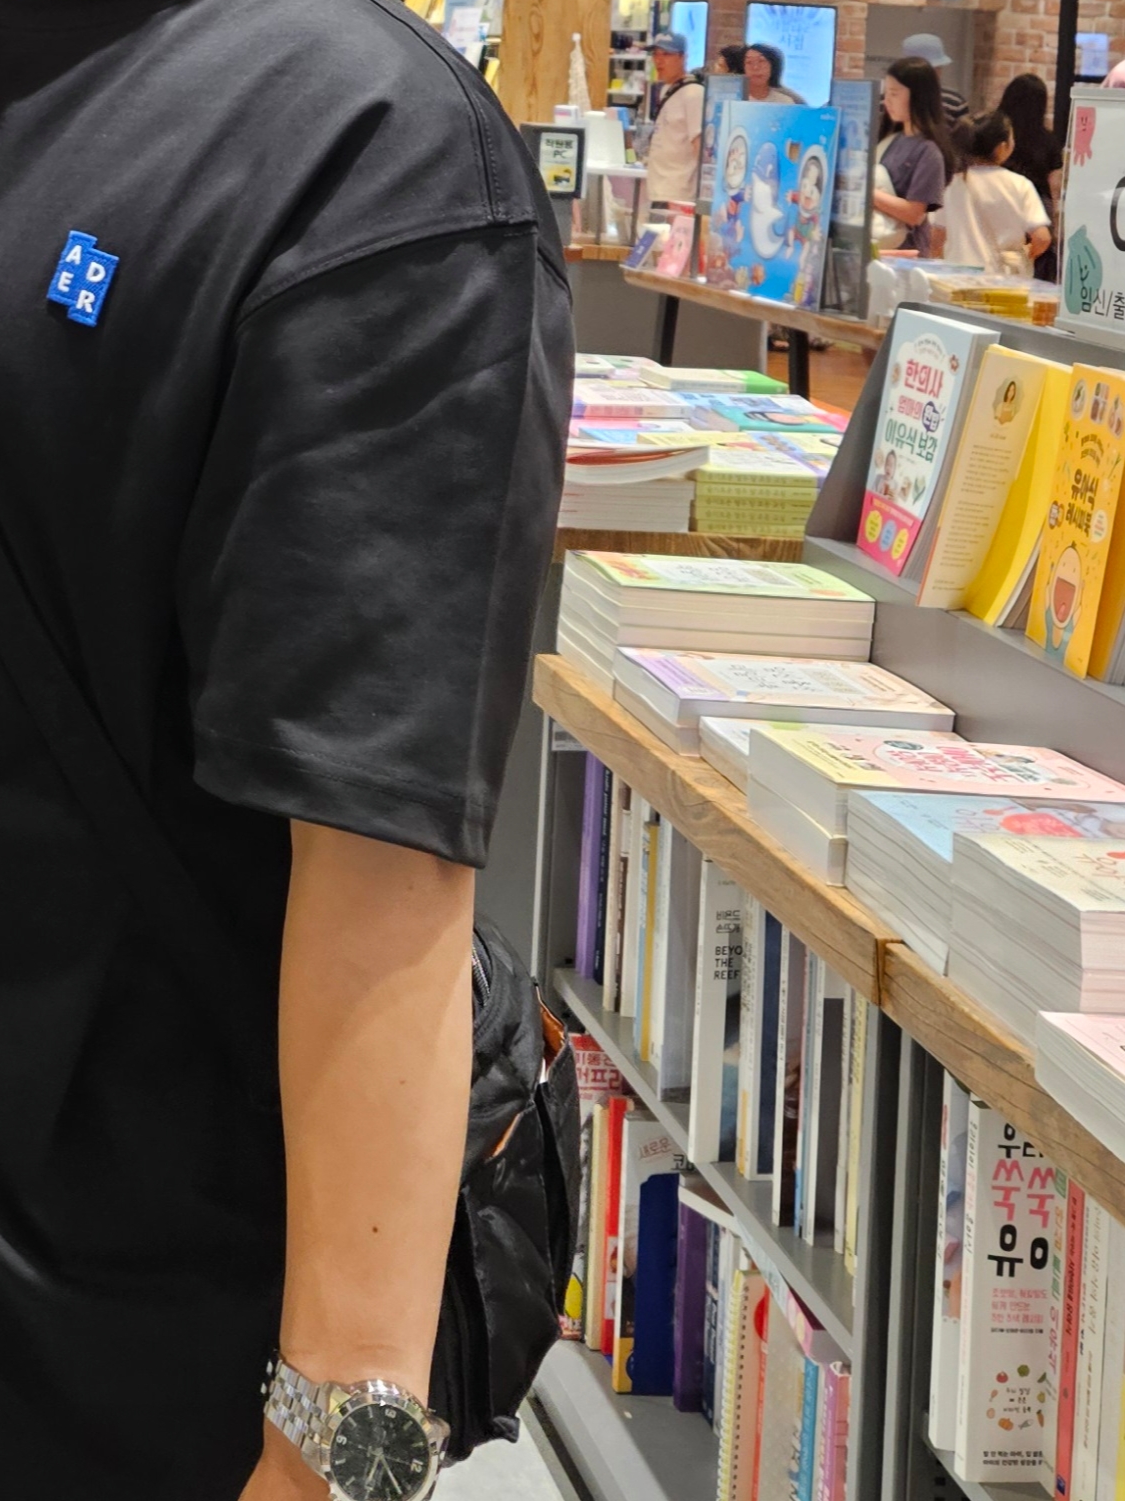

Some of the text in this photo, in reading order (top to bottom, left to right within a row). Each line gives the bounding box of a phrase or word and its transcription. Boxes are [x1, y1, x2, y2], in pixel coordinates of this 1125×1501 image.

[903, 358, 945, 400] 한의사
[884, 418, 918, 456] 이유식
[715, 945, 743, 956] BEYO
[713, 969, 741, 981] REEF
[715, 958, 734, 969] THE
[991, 1159, 1056, 1229] 쑥쑥
